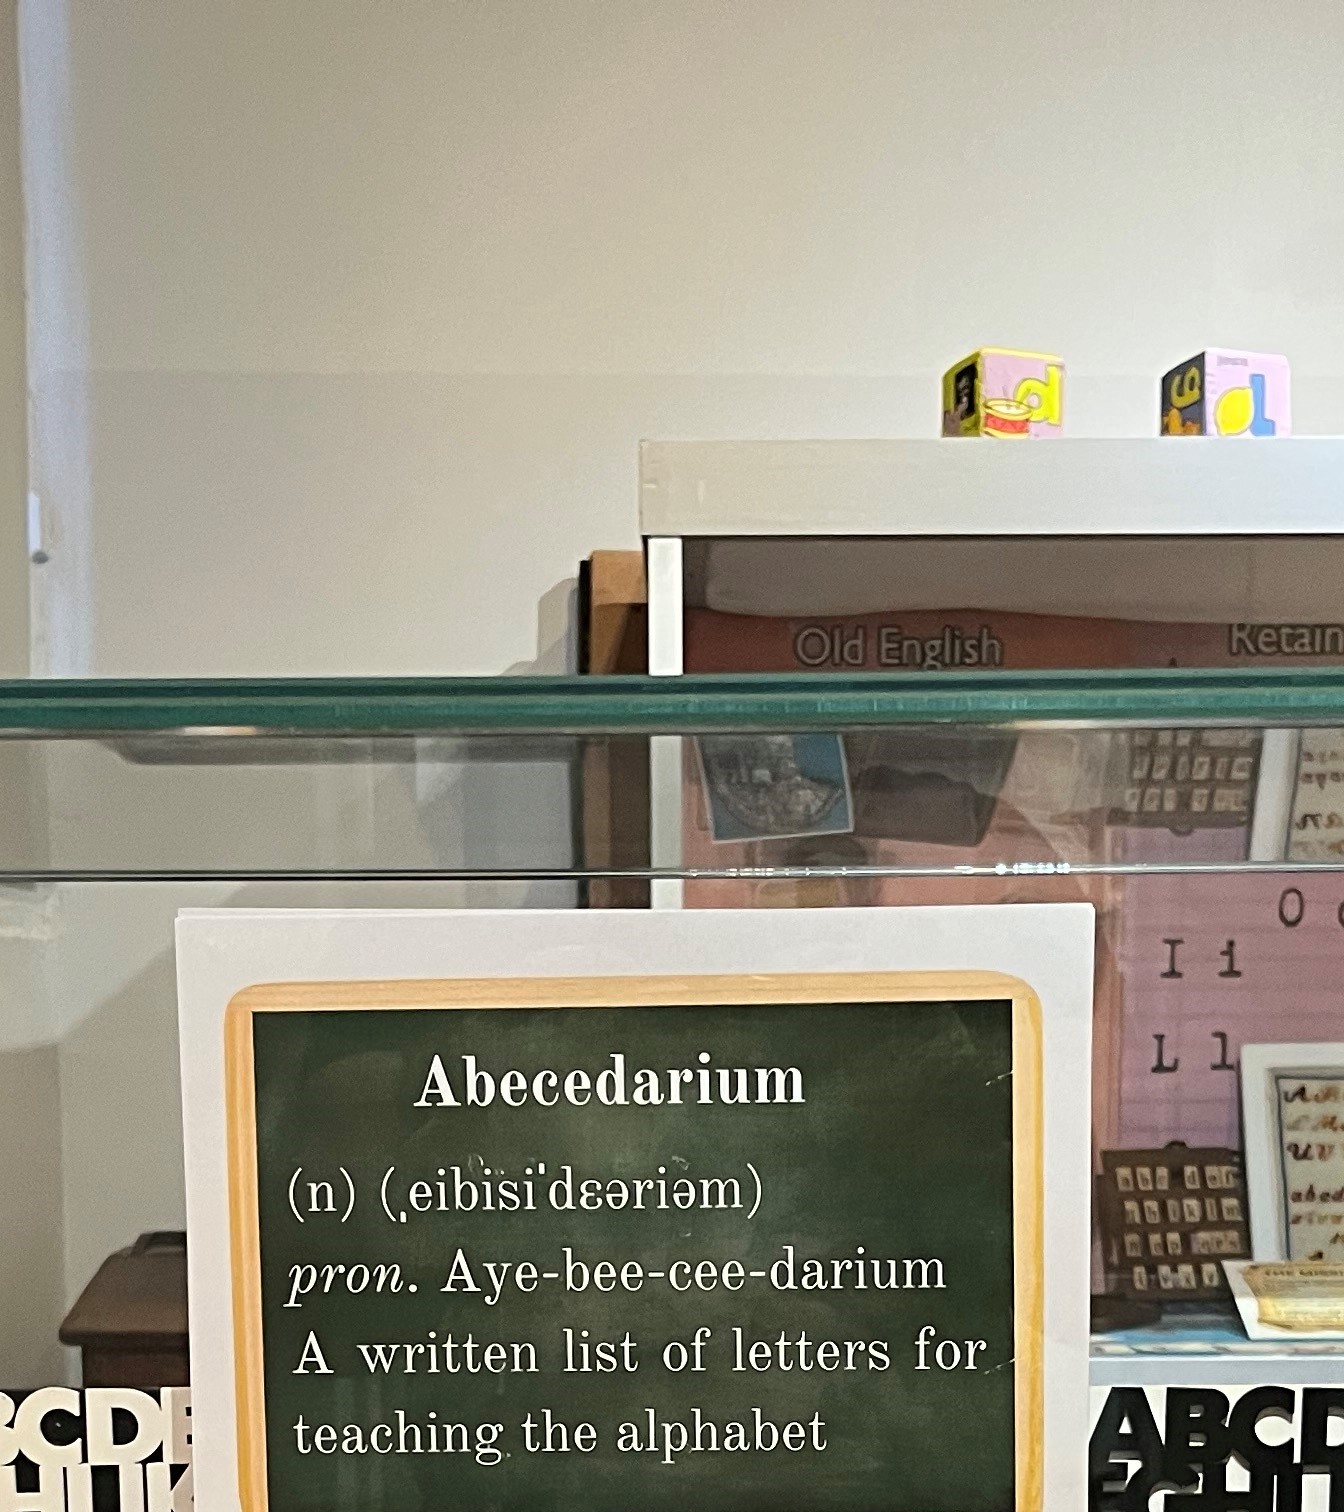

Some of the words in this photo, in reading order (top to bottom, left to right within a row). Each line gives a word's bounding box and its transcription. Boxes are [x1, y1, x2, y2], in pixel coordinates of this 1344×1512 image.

[1016, 364, 1063, 426] d
[794, 626, 864, 666] Old
[879, 625, 1005, 671] English
[1278, 887, 1305, 929] O
[1160, 938, 1185, 979] I
[1218, 939, 1243, 979] i
[413, 1051, 807, 1110] Abecedarium
[1151, 1033, 1180, 1074] L
[287, 1165, 357, 1224] (n)
[283, 1254, 419, 1310] pron.
[441, 1245, 948, 1308] Aye-bee-cee-darium
[292, 1330, 335, 1376] A
[356, 1329, 539, 1376] written
[563, 1327, 640, 1374] list
[662, 1326, 714, 1374] of
[732, 1327, 893, 1374] letters
[916, 1324, 989, 1374] for
[292, 1408, 505, 1468] teaching
[520, 1408, 599, 1455] the
[616, 1409, 829, 1464] alphabet
